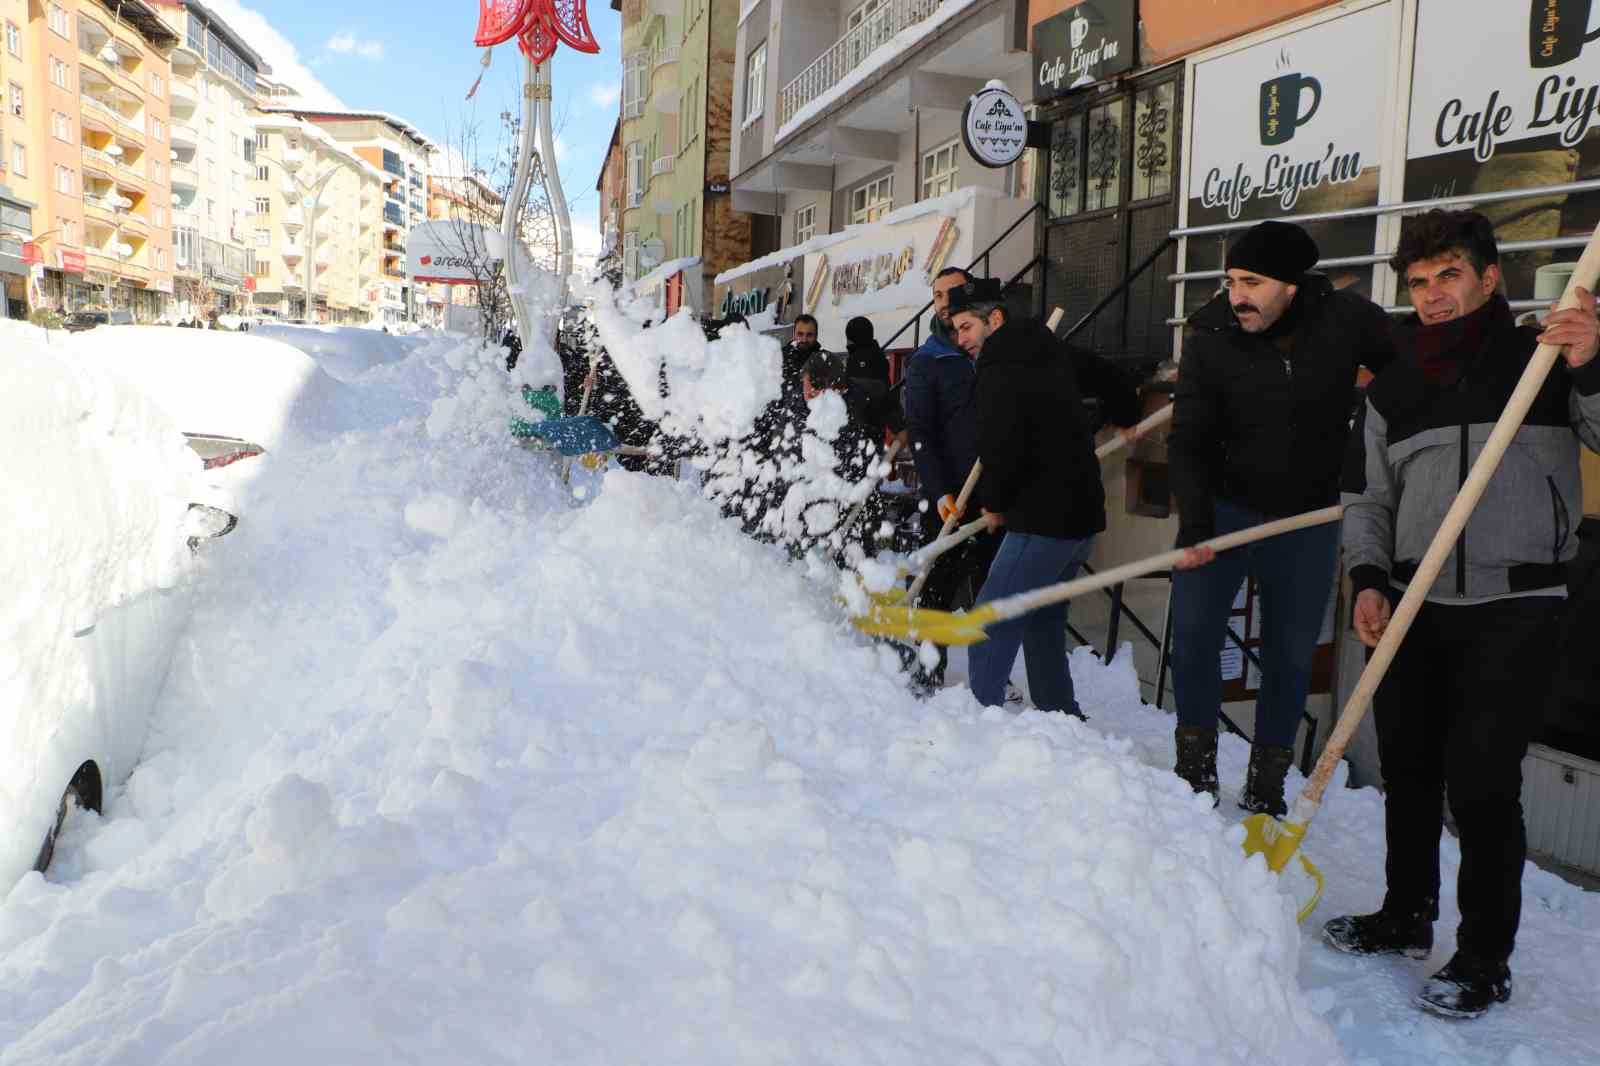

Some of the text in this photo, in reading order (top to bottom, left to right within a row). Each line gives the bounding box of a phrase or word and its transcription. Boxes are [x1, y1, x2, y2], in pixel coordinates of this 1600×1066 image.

[1039, 37, 1119, 88] Cafe Liya'm
[975, 119, 992, 133] Cafe
[1434, 74, 1600, 160] Cafe Liy
[1202, 142, 1362, 219] Cafe Liya'm
